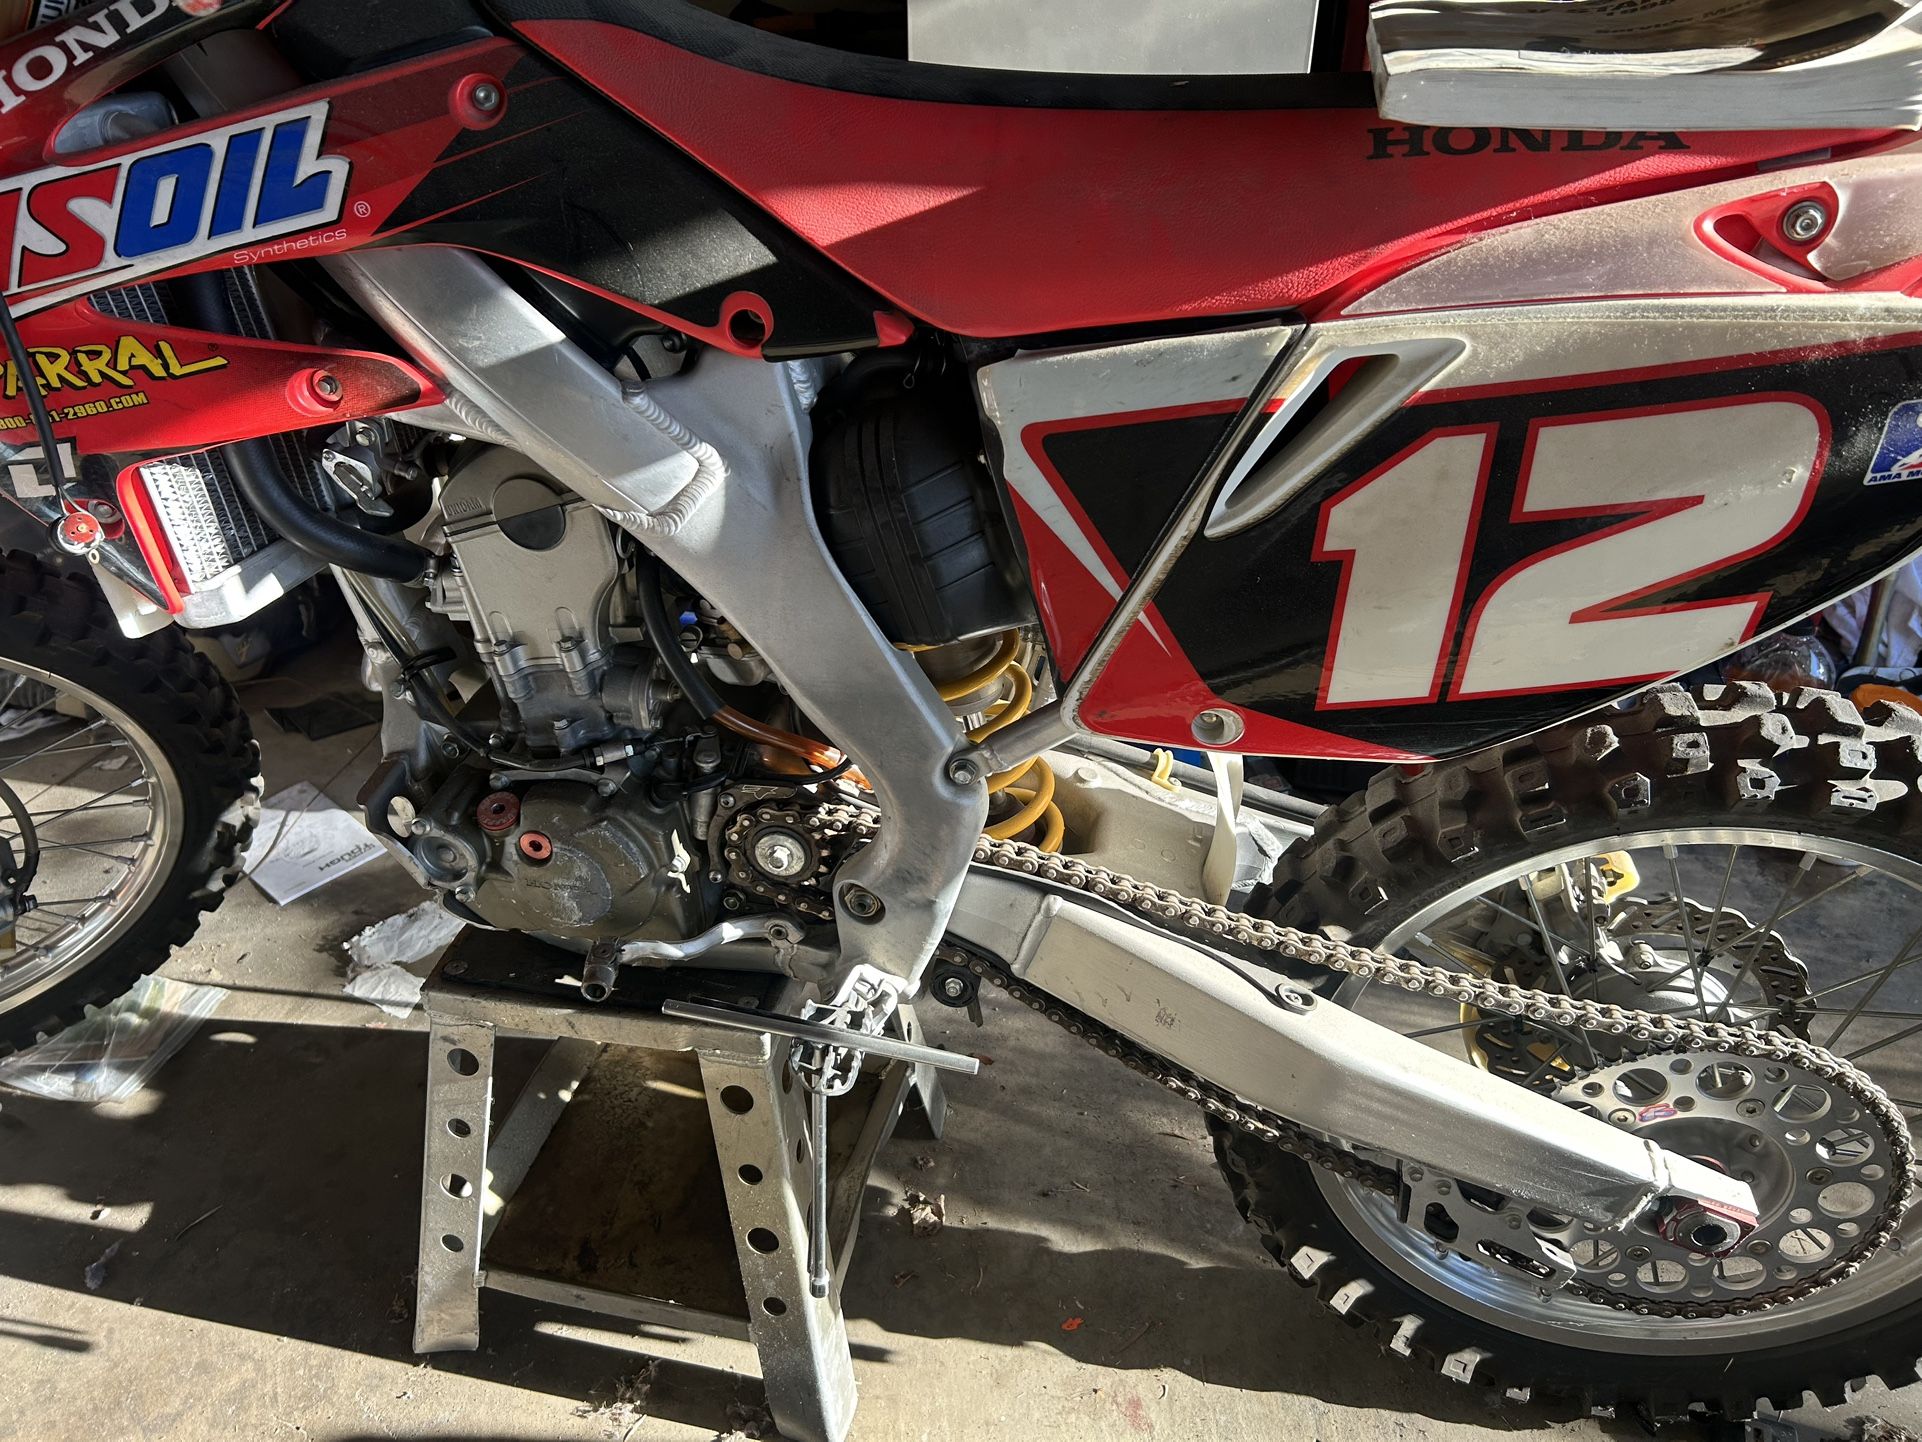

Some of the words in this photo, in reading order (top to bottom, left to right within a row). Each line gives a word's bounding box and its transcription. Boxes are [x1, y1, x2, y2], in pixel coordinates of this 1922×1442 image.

[0, 0, 176, 114] OND
[0, 107, 342, 295] SOIL
[233, 228, 347, 264] Synthetics
[1867, 472, 1902, 484] AMA
[1310, 390, 1832, 711] 12
